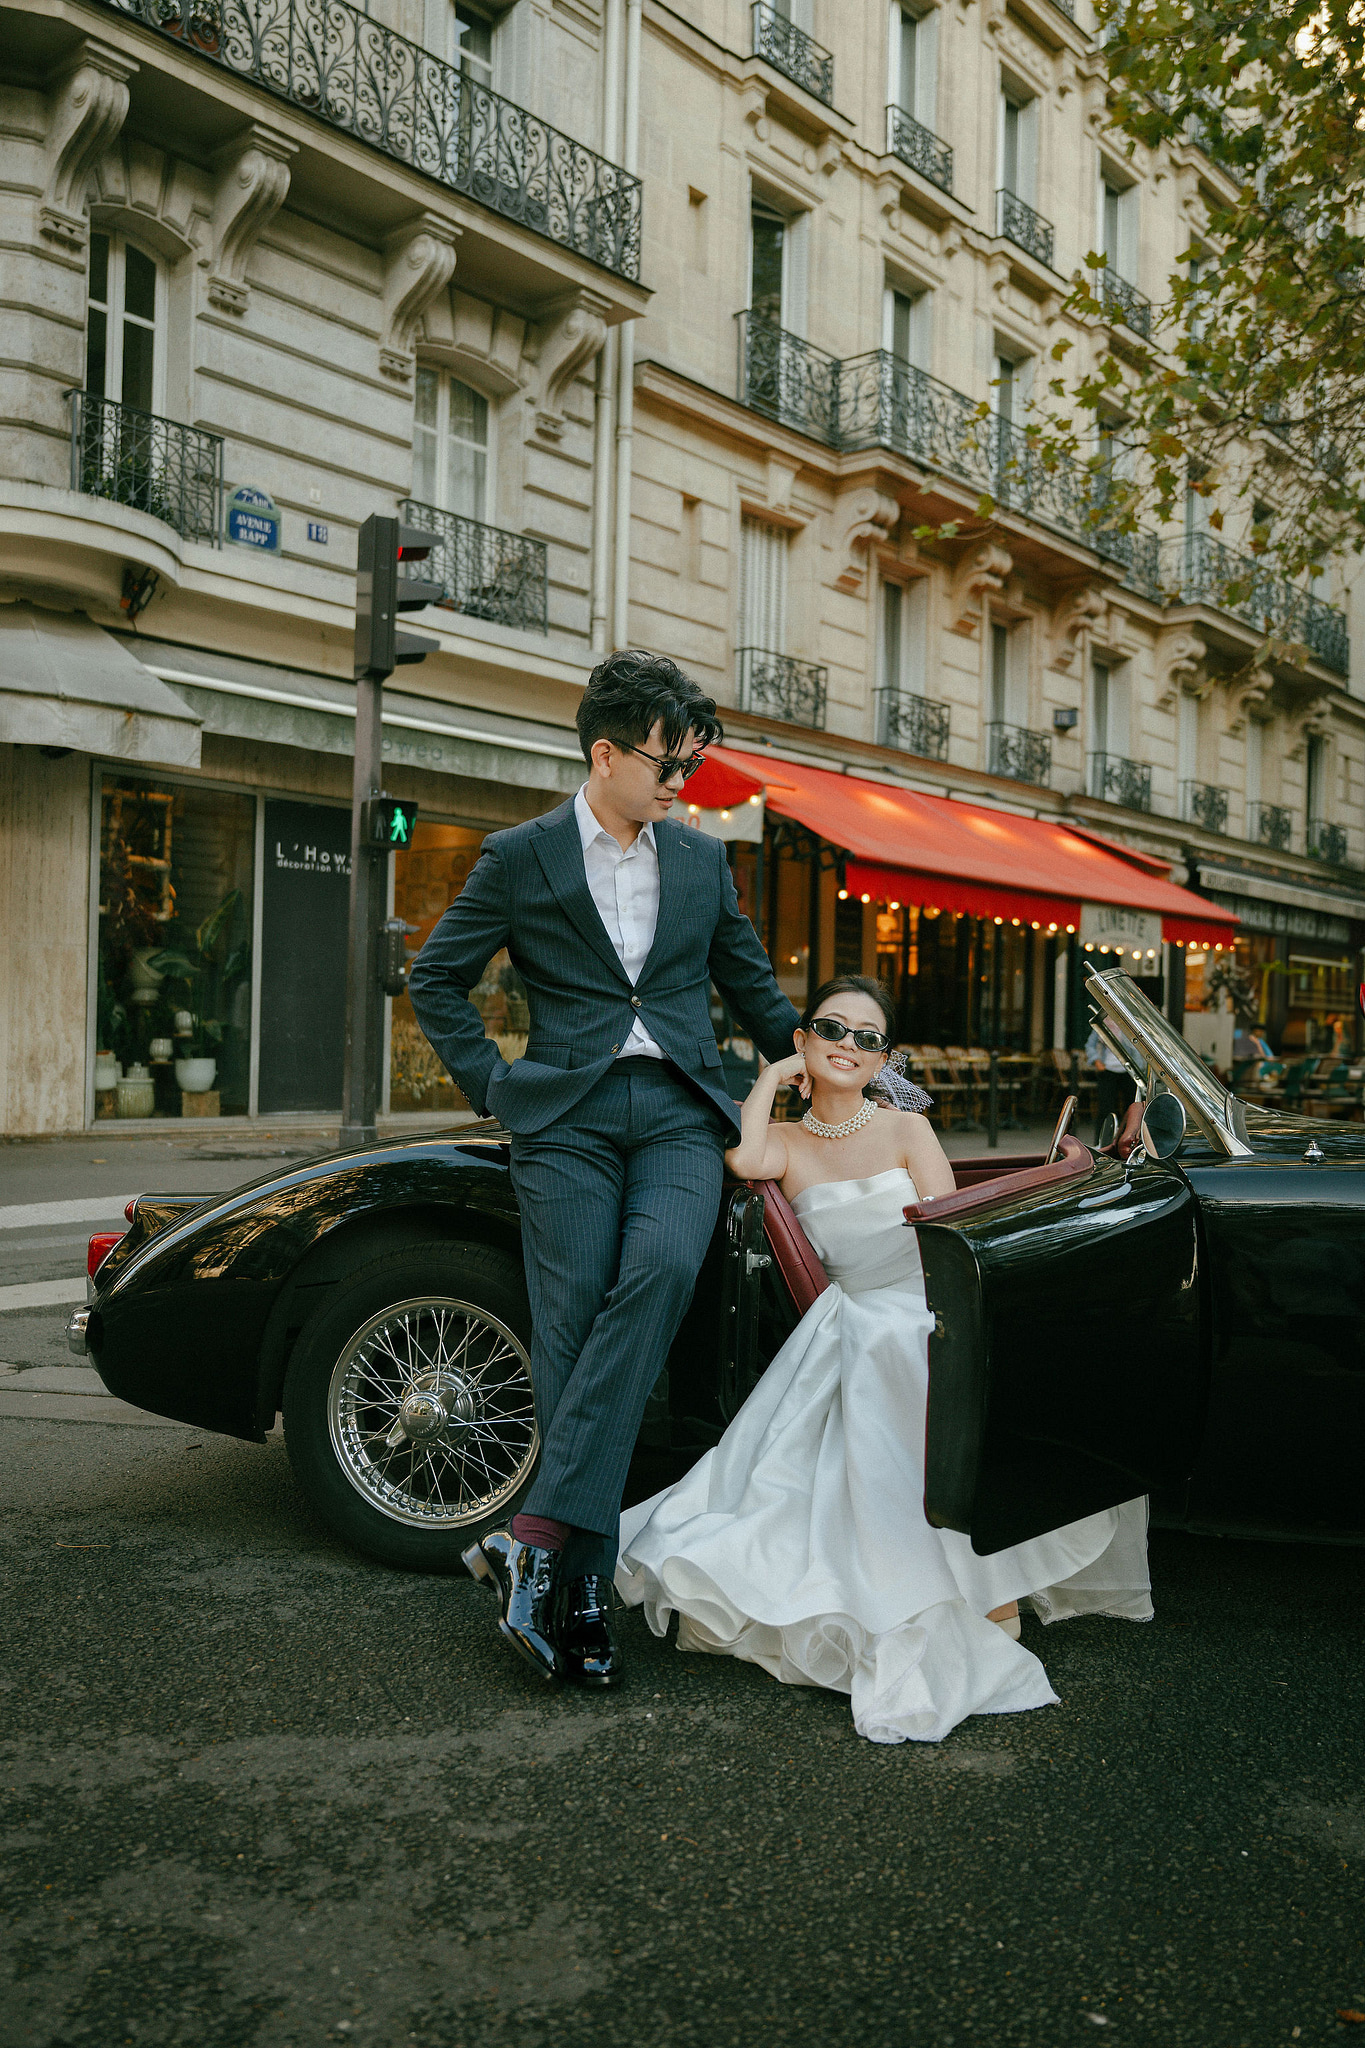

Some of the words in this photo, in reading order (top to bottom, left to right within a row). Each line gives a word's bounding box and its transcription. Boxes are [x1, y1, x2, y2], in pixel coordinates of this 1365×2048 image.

[236, 514, 271, 534] AVENUE
[311, 524, 328, 543] 18
[240, 527, 268, 545] RAPP
[275, 841, 353, 865] L'How
[1097, 908, 1147, 938] LINETTE
